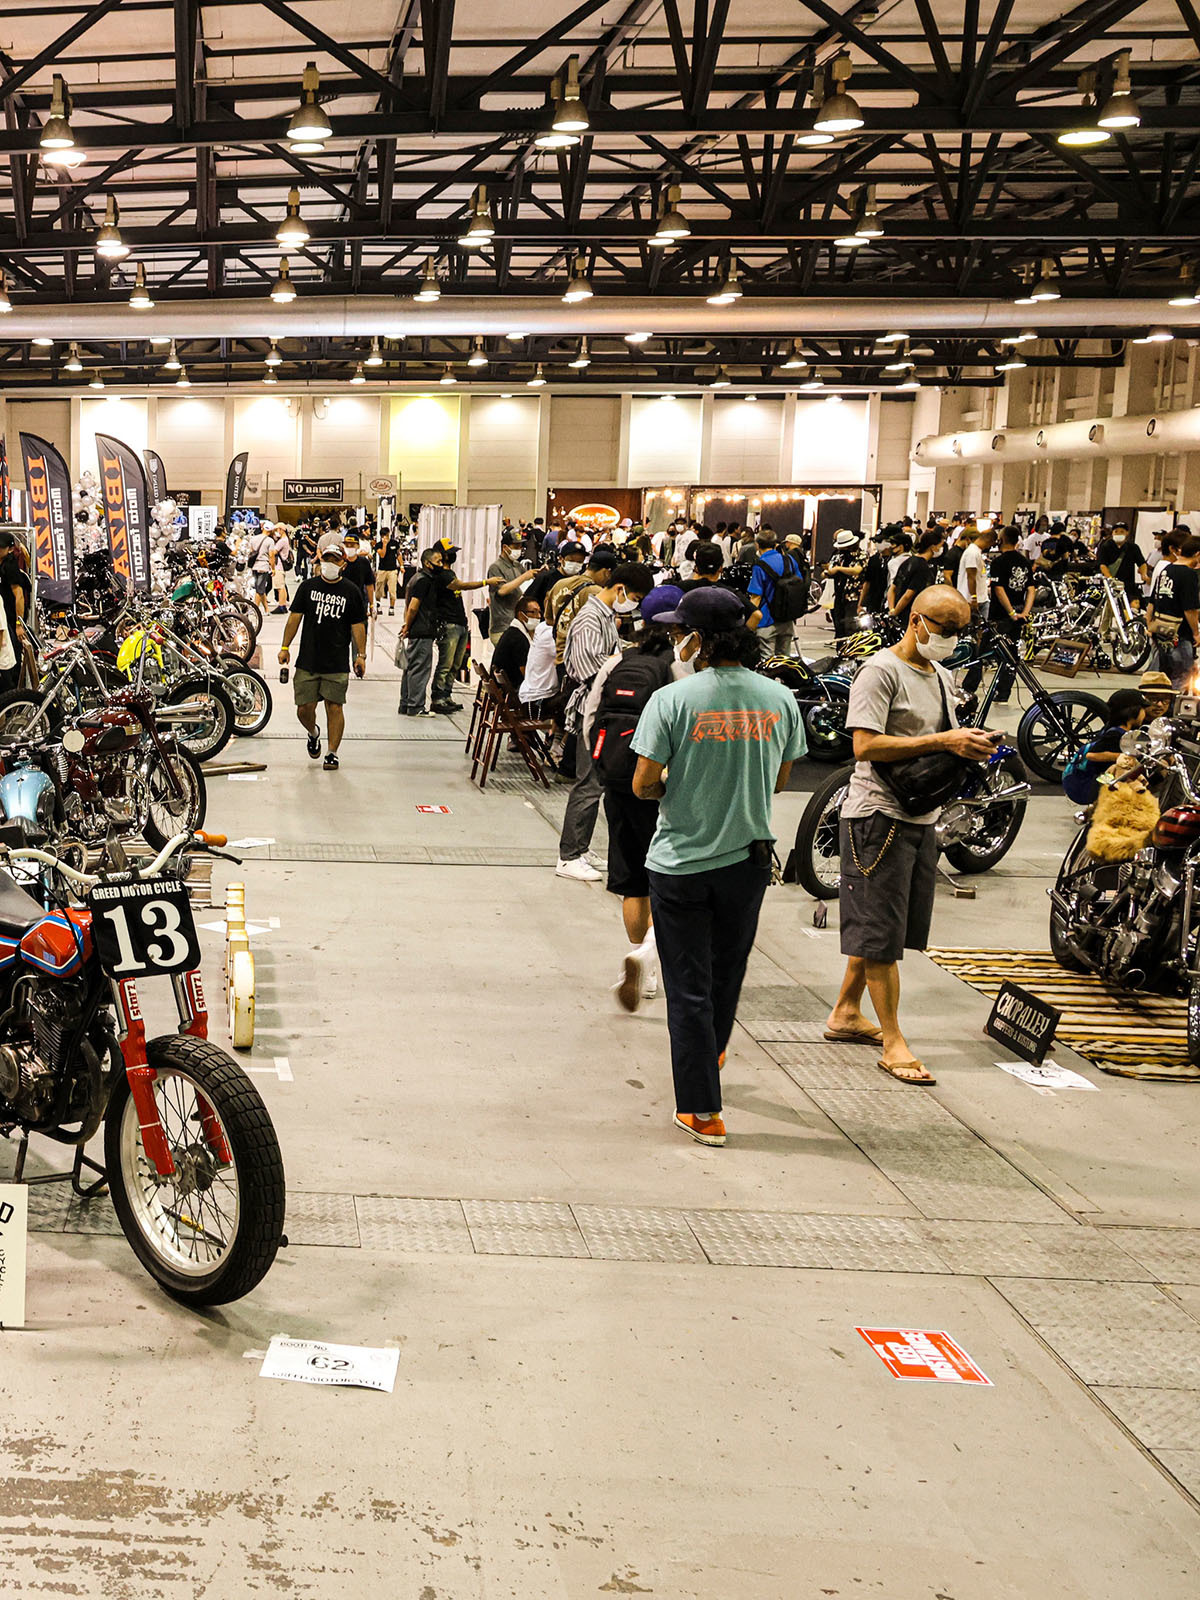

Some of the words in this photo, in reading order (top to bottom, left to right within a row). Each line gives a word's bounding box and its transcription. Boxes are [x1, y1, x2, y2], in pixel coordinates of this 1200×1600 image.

[287, 484, 304, 494] NO
[305, 484, 340, 494] name!
[92, 887, 121, 900] GREED
[120, 884, 154, 898] MOTOR
[153, 880, 182, 894] CYCLE
[103, 900, 190, 973] 13
[310, 1356, 350, 1372] 62
